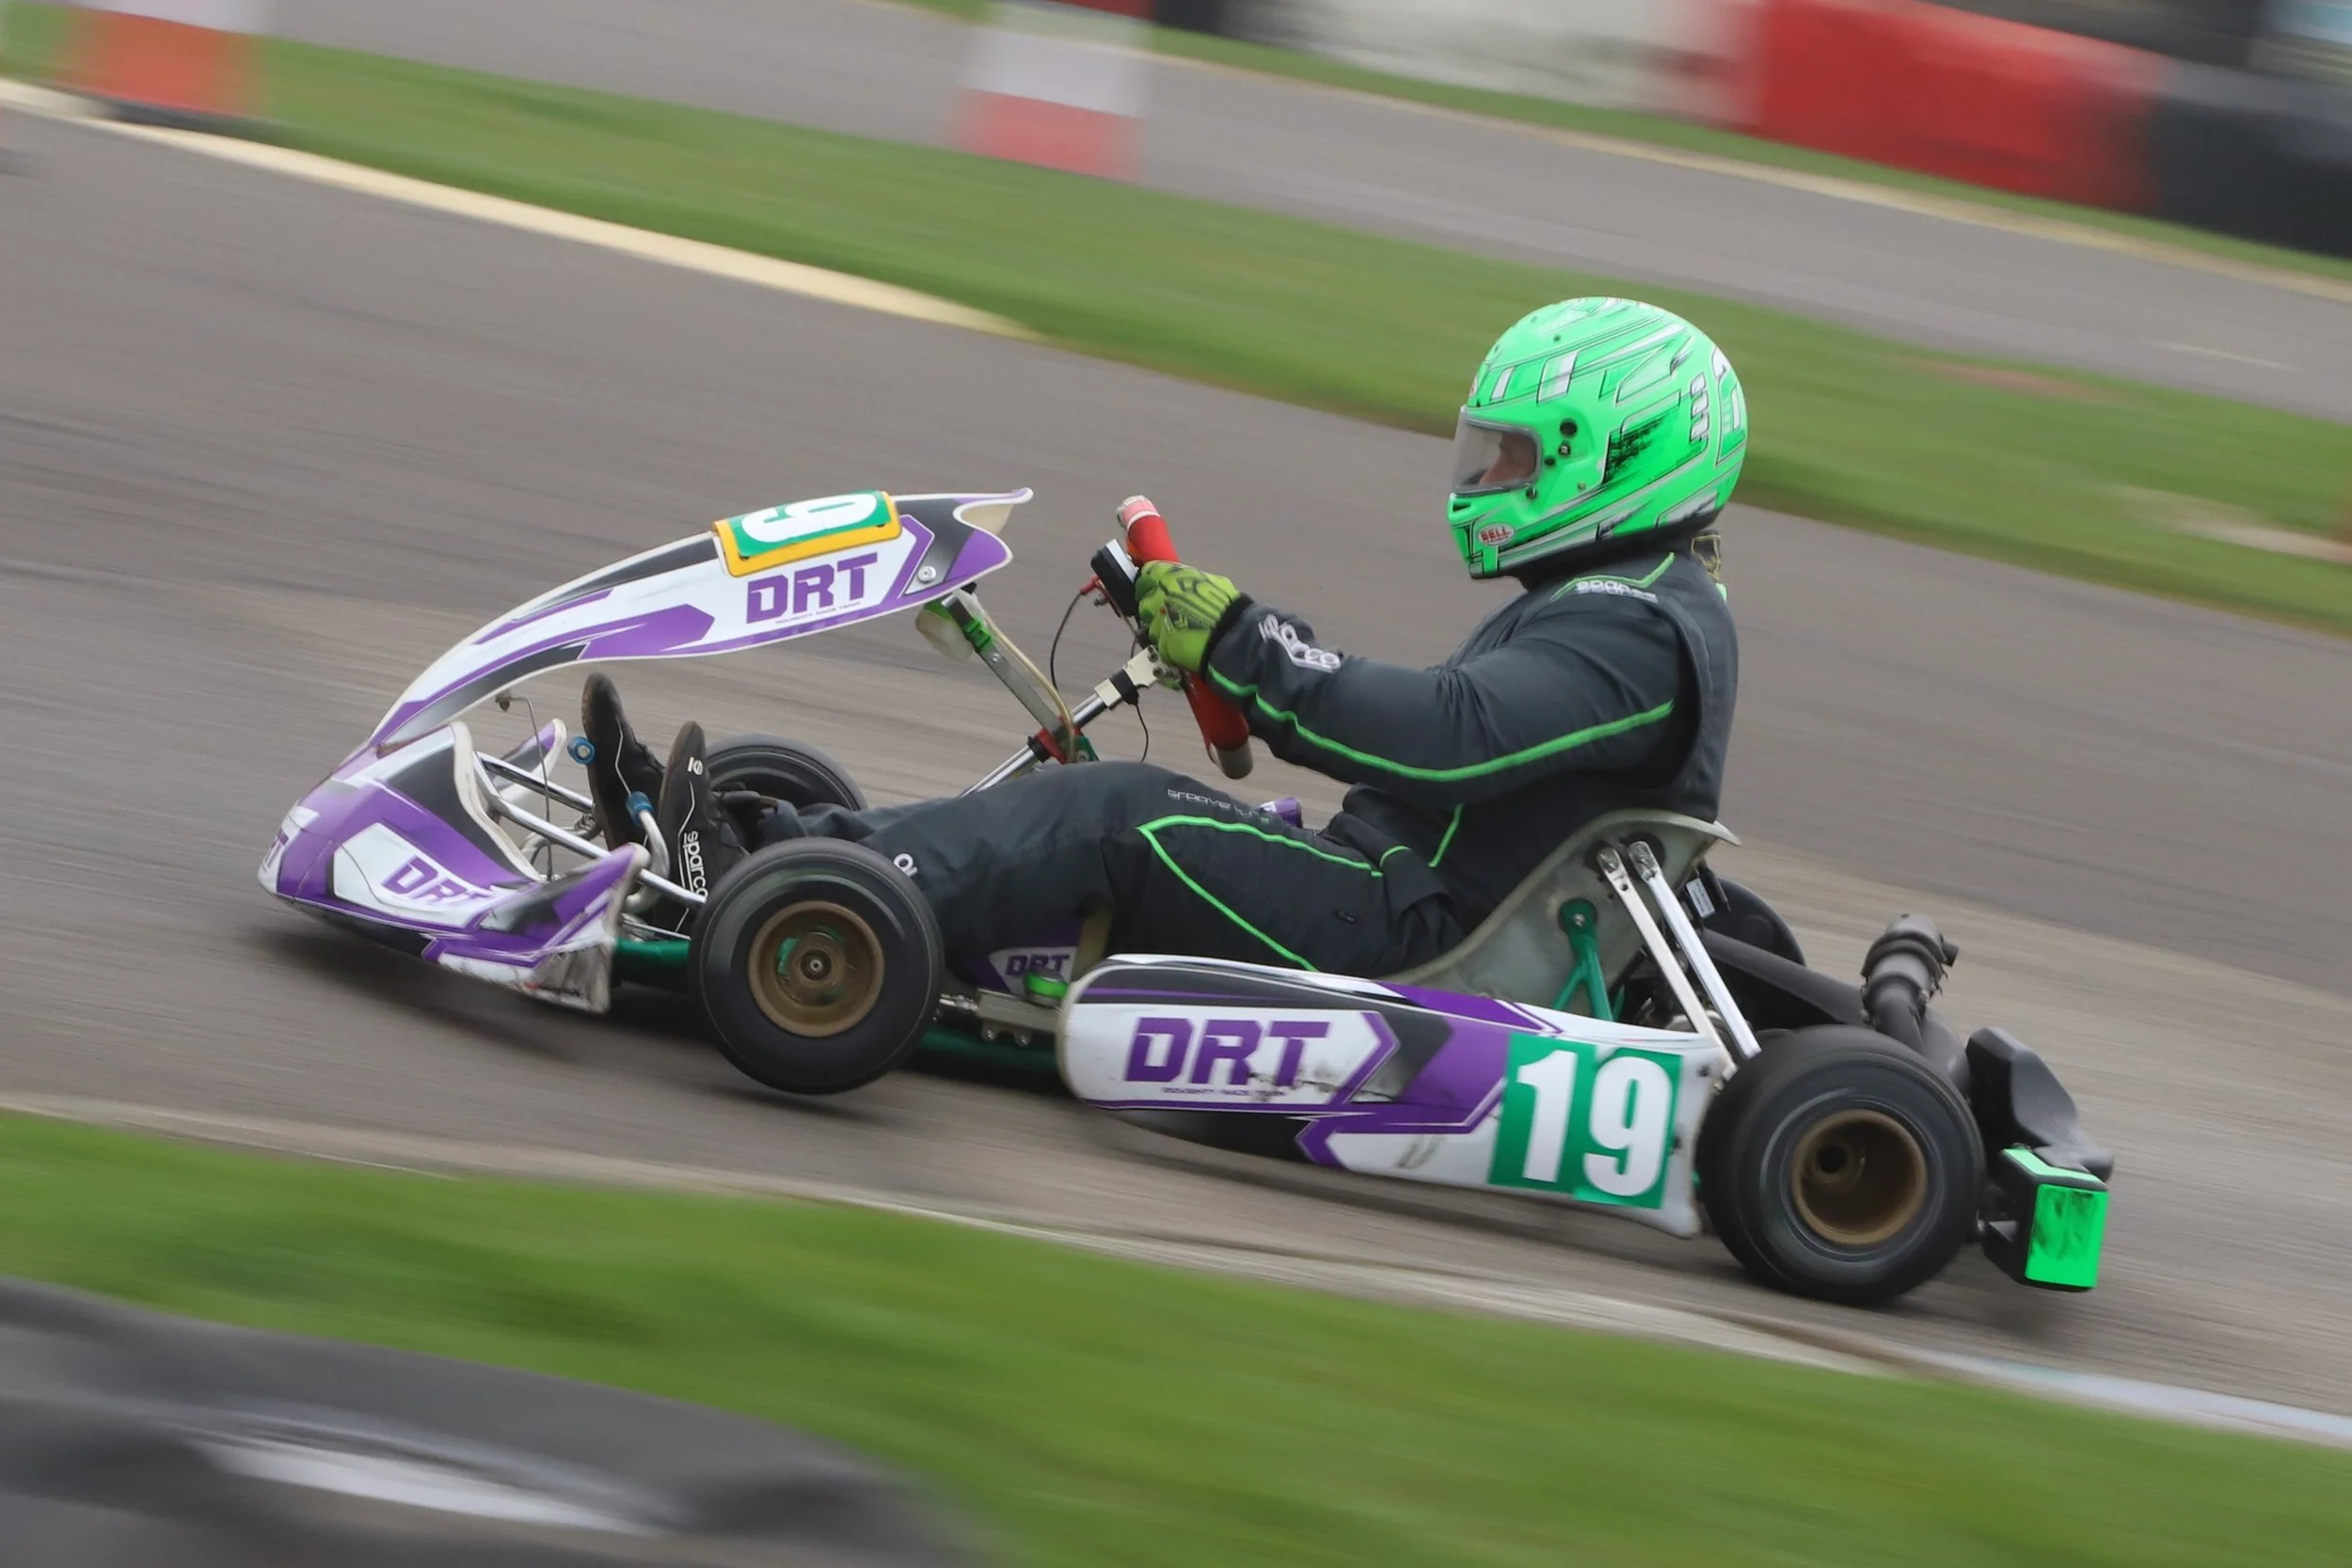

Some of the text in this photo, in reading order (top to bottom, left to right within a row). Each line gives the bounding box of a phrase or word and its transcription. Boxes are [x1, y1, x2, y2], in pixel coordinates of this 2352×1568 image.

[1480, 526, 1512, 541] BELL
[746, 552, 878, 625] DRT
[1125, 1017, 1330, 1086] DRT
[1517, 1050, 1672, 1197] 19
